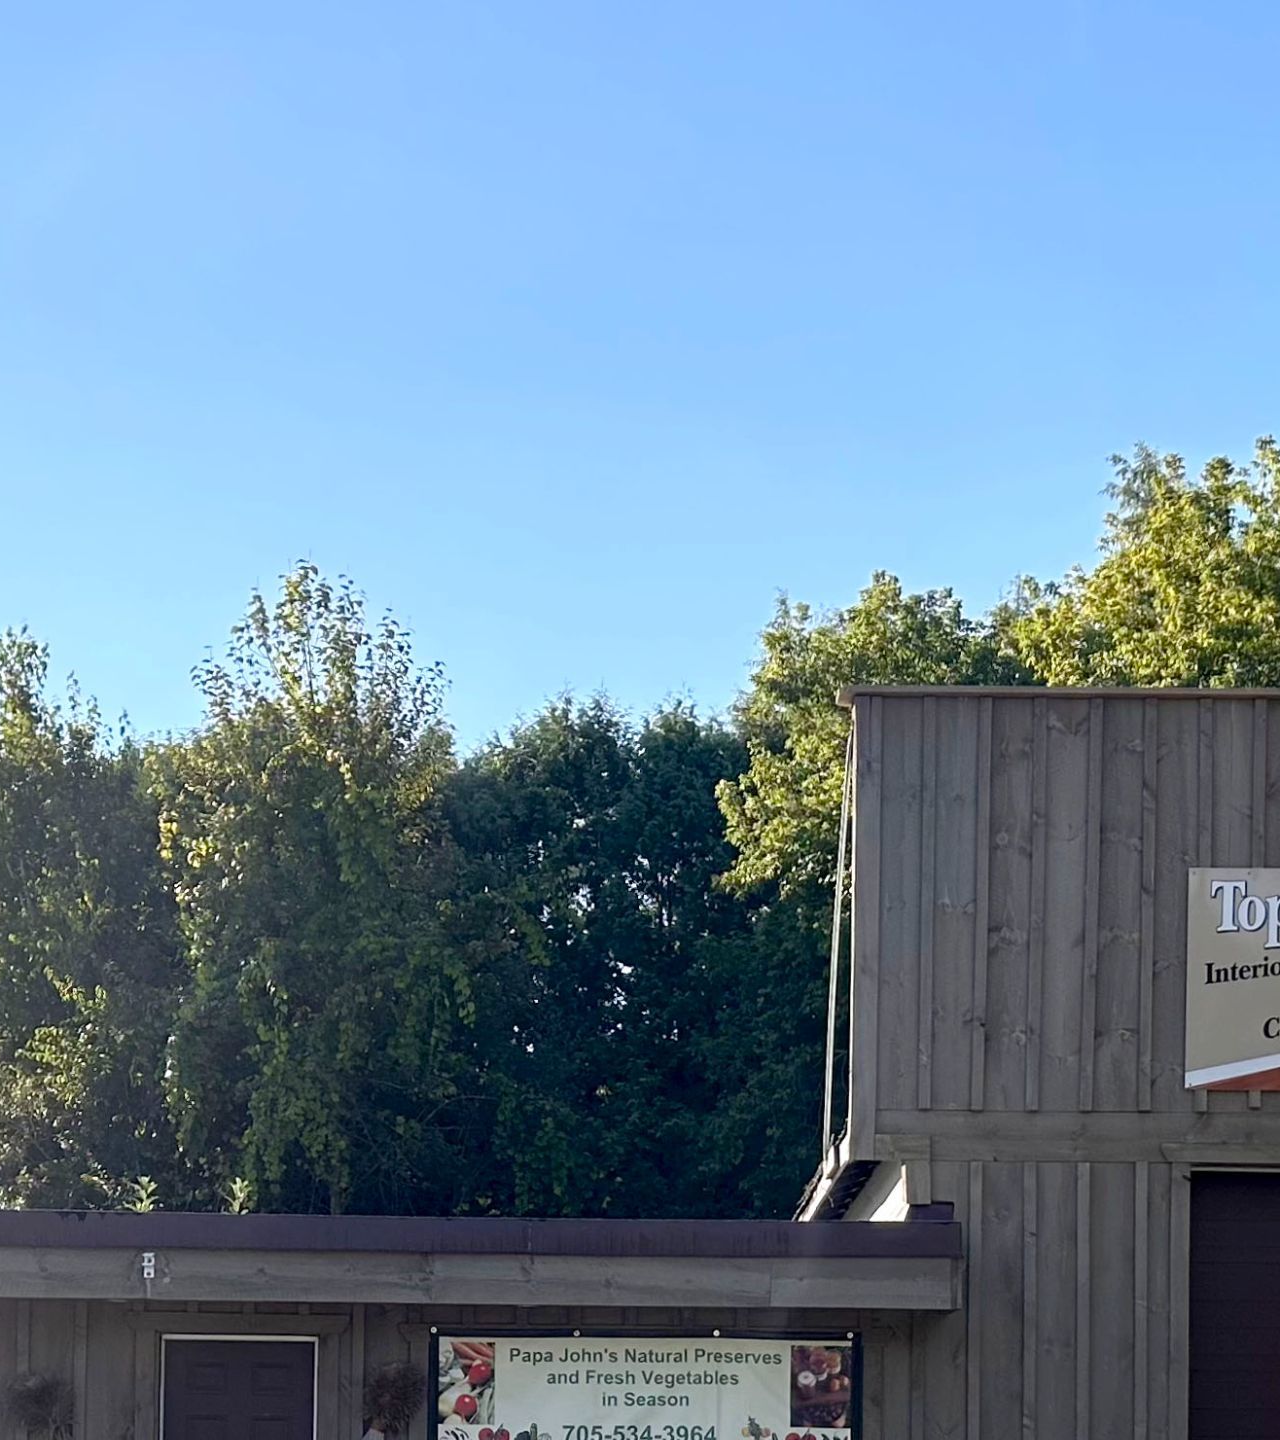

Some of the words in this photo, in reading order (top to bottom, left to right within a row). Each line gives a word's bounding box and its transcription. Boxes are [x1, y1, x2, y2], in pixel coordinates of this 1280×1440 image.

[509, 1347, 553, 1366] Papa
[559, 1347, 618, 1364] John's
[624, 1348, 687, 1364] Natural
[694, 1349, 782, 1365] Preserves
[546, 1369, 579, 1385] and
[585, 1370, 636, 1385] Fresh
[642, 1370, 739, 1388] Vegetables
[602, 1391, 618, 1407] in
[624, 1392, 690, 1407] Season
